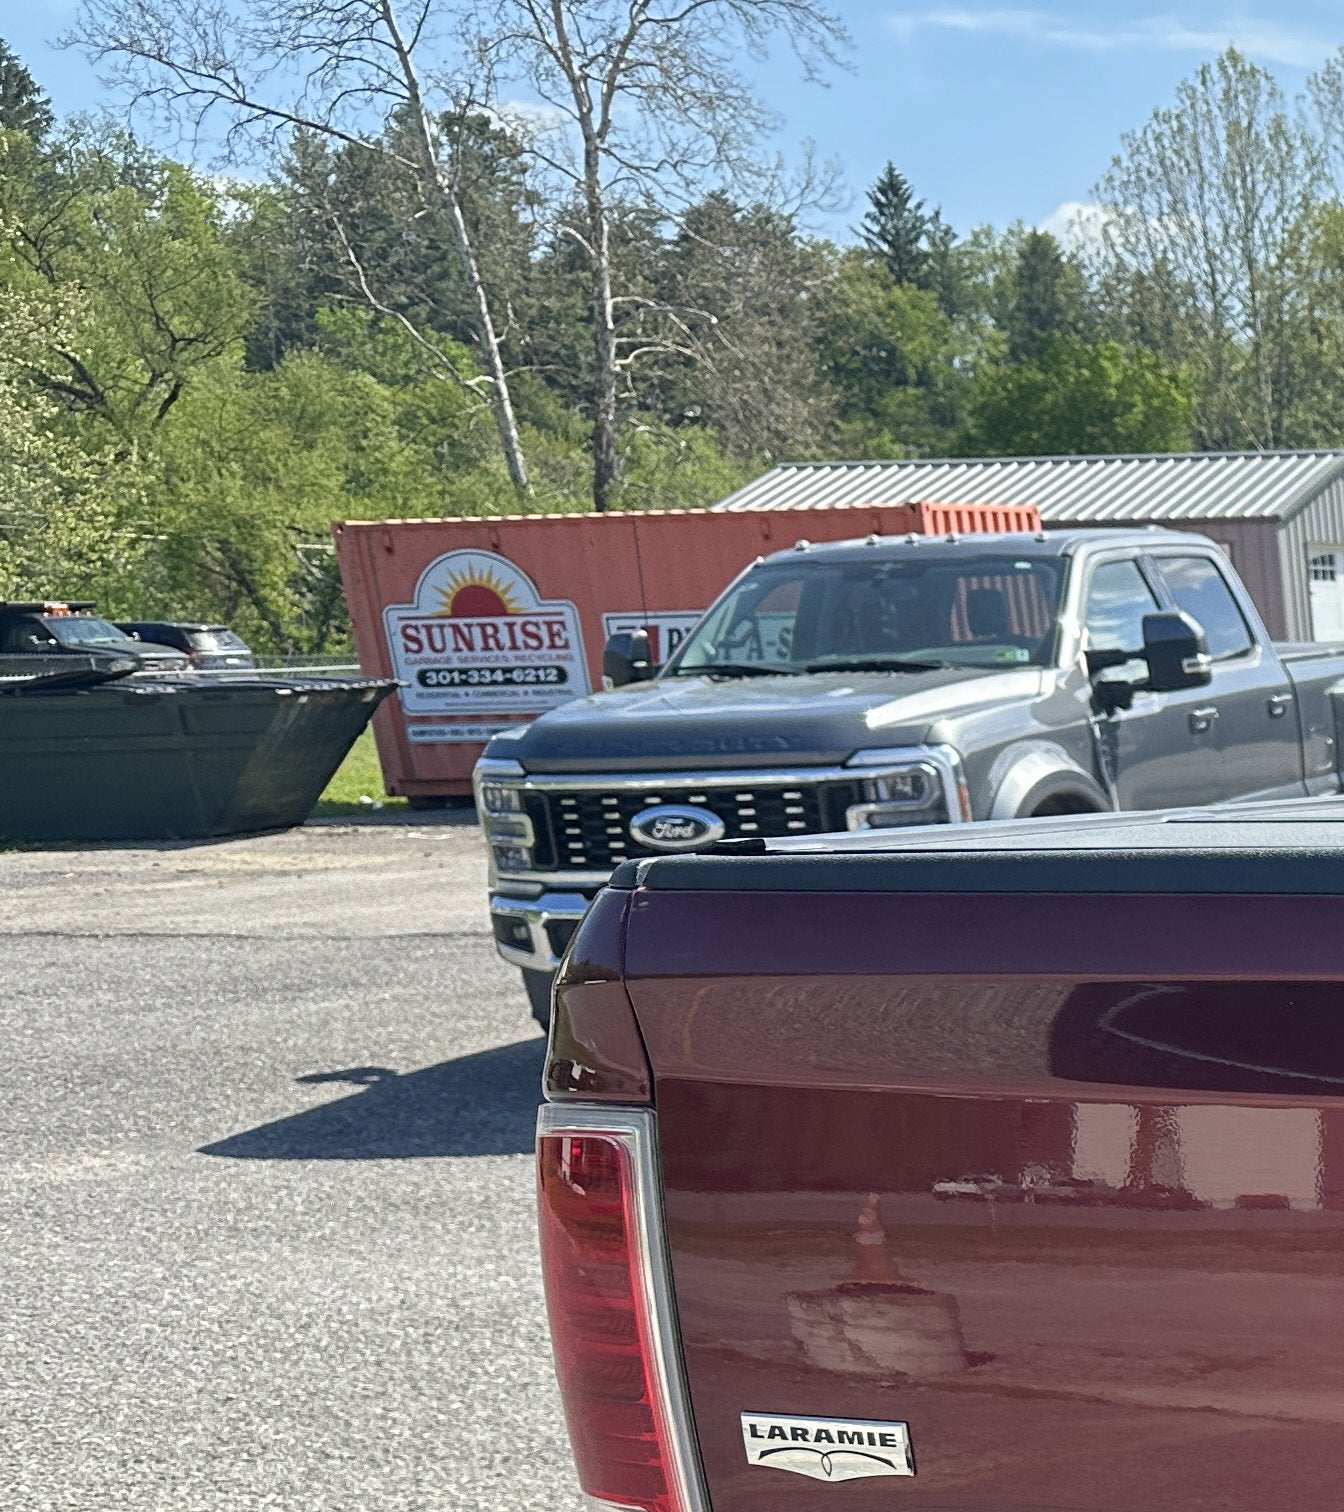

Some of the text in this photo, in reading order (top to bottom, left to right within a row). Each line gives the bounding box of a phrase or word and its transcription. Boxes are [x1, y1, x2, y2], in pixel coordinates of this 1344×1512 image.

[400, 619, 571, 654] SUNRISE
[404, 655, 452, 666] GARBAGE
[425, 667, 559, 686] 301-334-6212
[652, 819, 695, 839] Ford
[749, 1423, 897, 1448] LARAMIE
